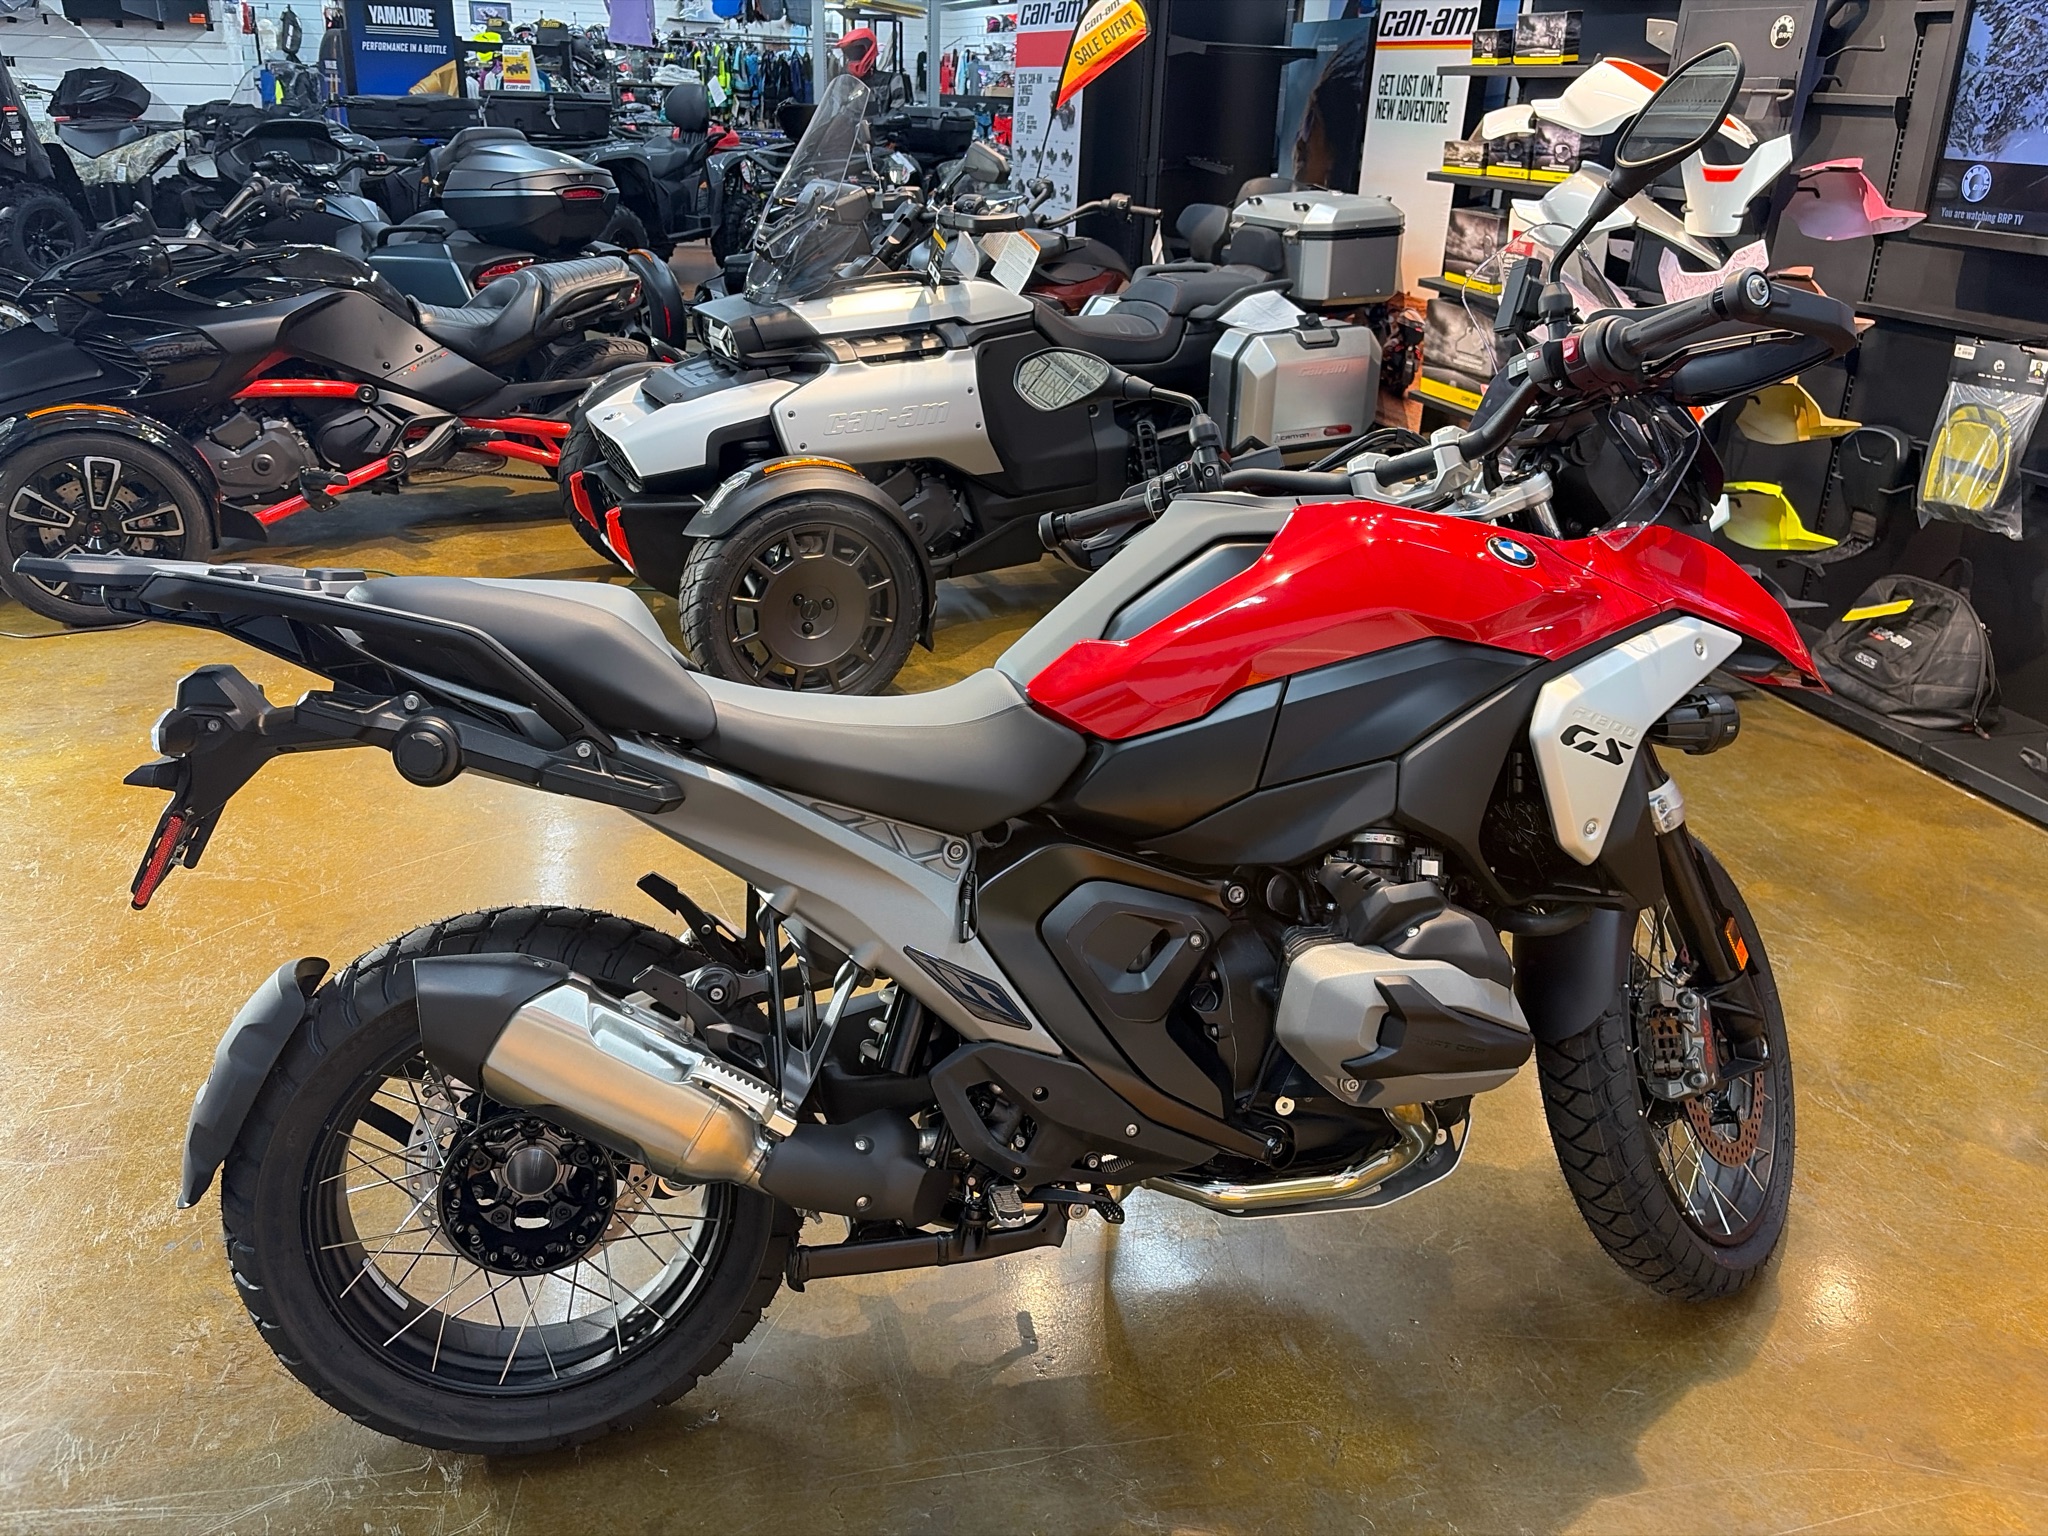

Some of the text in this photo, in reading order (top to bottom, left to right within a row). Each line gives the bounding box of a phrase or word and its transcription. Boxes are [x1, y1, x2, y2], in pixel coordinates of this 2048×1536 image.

[368, 5, 434, 27] YAMALUBE
[1020, 0, 1083, 25] can-am
[1084, 0, 1121, 32] can-am
[1379, 7, 1478, 37] can-am
[362, 41, 447, 55] PERFORMANCE IN A BOTTLE
[1074, 10, 1137, 66] SALE EVENT
[1378, 74, 1443, 98] GET LOST ON A
[1375, 98, 1450, 123] NEW ADVENTURE
[1941, 207, 2024, 225] You are watching BRP TV
[823, 401, 950, 436] can-am
[1281, 433, 1309, 441] CANYON
[1560, 724, 1634, 766] GS
